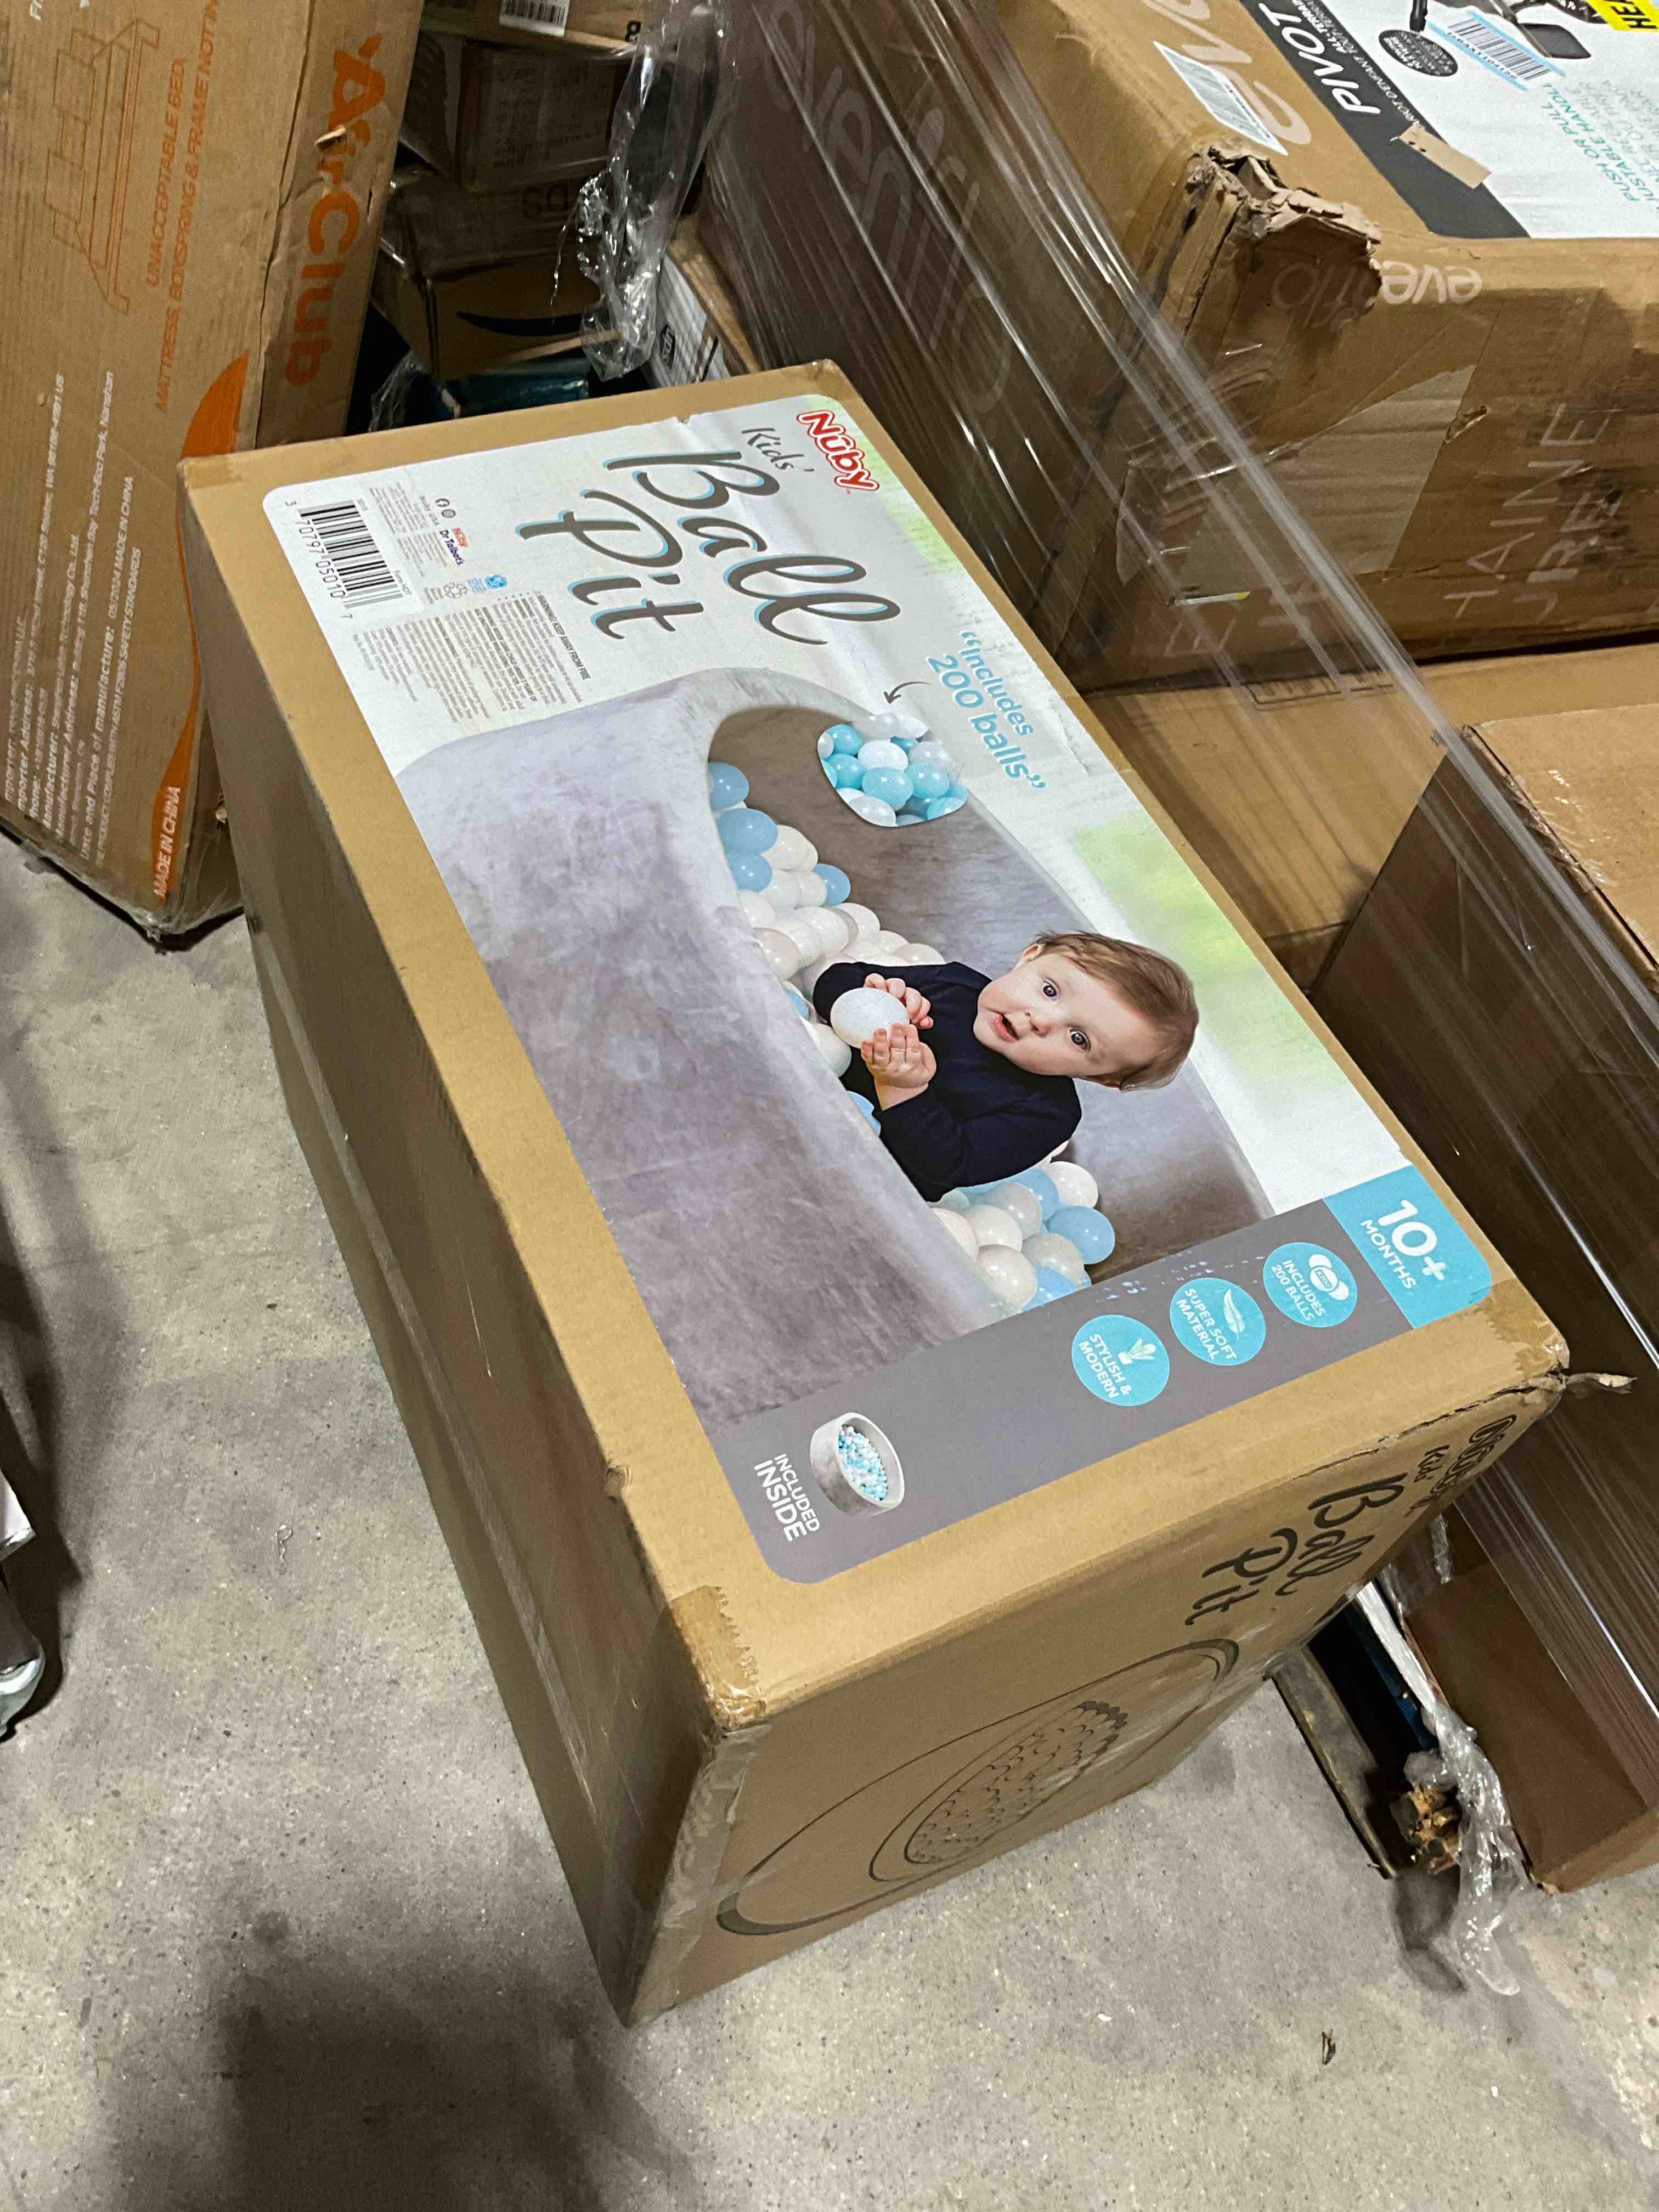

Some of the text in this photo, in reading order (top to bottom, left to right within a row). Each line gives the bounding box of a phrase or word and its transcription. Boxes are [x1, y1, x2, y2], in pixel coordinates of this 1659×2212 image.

[1259, 3, 1381, 114] PIVOT
[187, 75, 208, 160] FRAME
[1541, 101, 1578, 135] PULL
[184, 160, 199, 179] &
[1574, 139, 1600, 159] OR
[286, 35, 386, 386] AirClub
[119, 516, 128, 531] IN
[121, 476, 133, 516] CHINA
[114, 531, 127, 569] MADE
[295, 519, 325, 554] 70797
[315, 560, 346, 598] 05010
[515, 488, 704, 641] Pit
[603, 449, 901, 646] Ball
[94, 625, 115, 732] manufacture:
[552, 622, 566, 636] KEEP
[559, 635, 574, 651] AWAY
[568, 651, 584, 668] FROM
[577, 667, 591, 680] FIRE
[927, 654, 984, 708] 200
[92, 732, 101, 751] of
[87, 754, 100, 794] Place
[86, 795, 96, 825] and
[153, 785, 181, 898] MADE IN CHINA
[1360, 1220, 1417, 1289] MONTHS
[1378, 1200, 1446, 1280] 10+
[1271, 1265, 1315, 1321] 200 BALLS
[1283, 1260, 1325, 1317] INCLUDES
[1176, 1299, 1221, 1360] MATERIAL
[1185, 1288, 1237, 1359] SUPER SOFT
[1079, 1341, 1119, 1398] MODERN
[1090, 1334, 1132, 1396] STYLISH &
[754, 1459, 808, 1542] INSIDE
[774, 1453, 820, 1532] INCLUDED
[1276, 1472, 1408, 1597] Ball
[1184, 1527, 1299, 1626] Pit
